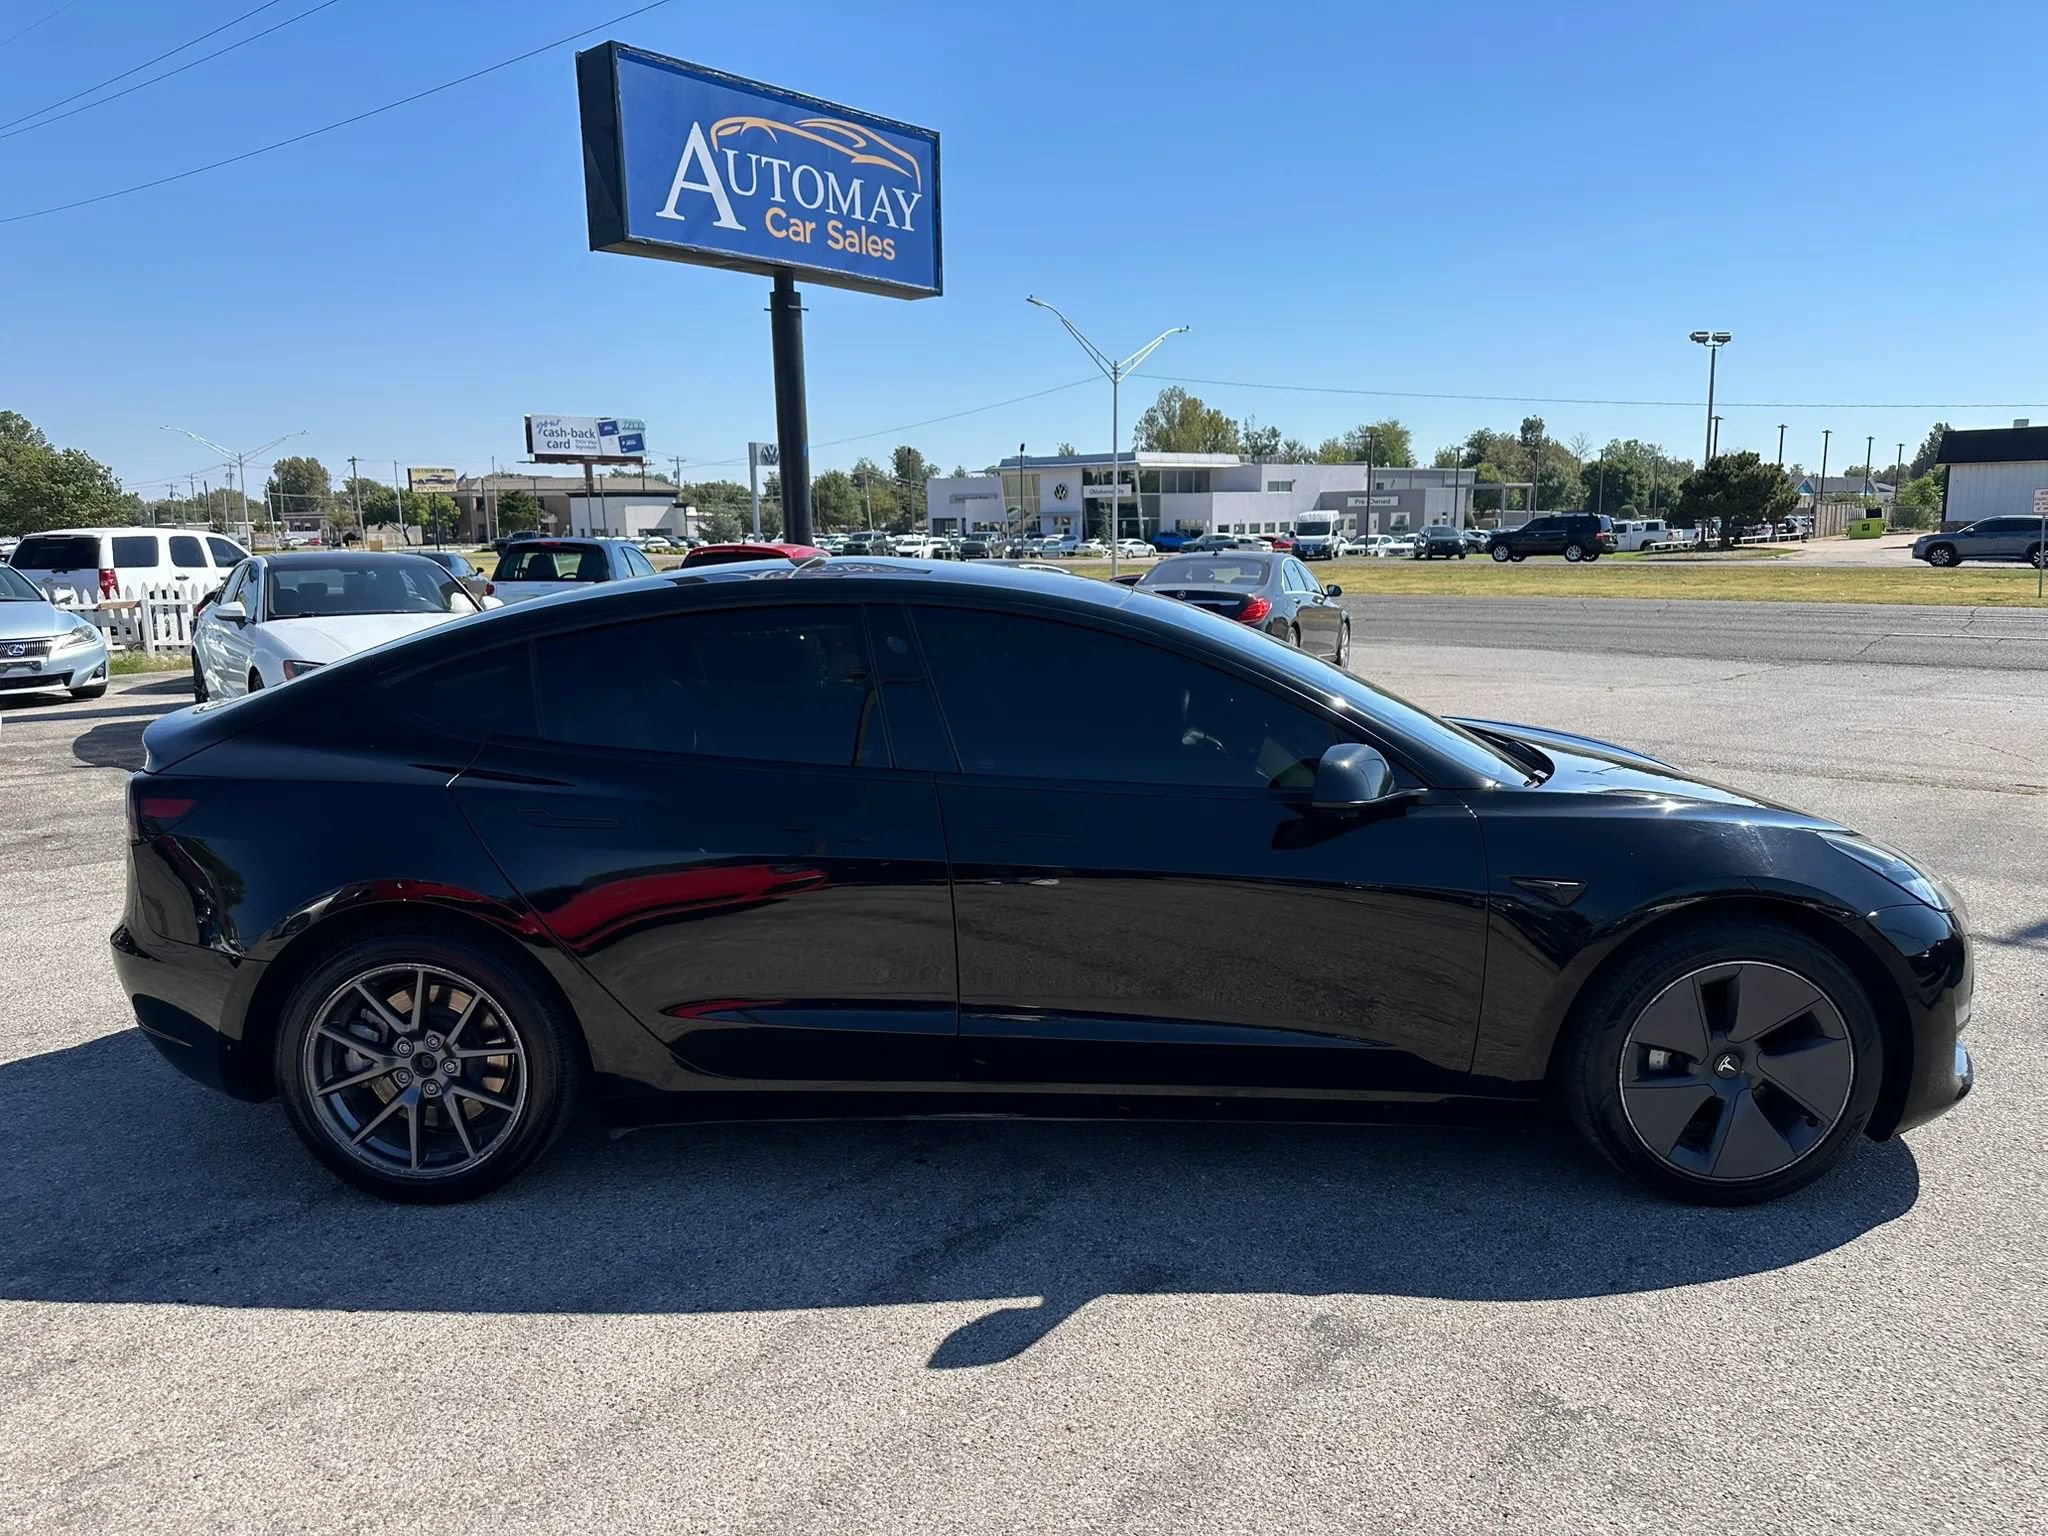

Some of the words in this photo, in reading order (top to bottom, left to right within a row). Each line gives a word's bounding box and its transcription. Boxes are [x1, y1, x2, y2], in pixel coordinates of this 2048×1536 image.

[655, 121, 922, 232] AUTOMAY
[765, 207, 817, 244] Car
[826, 219, 896, 261] Sales
[543, 427, 596, 439] cash-back
[546, 438, 571, 449] card
